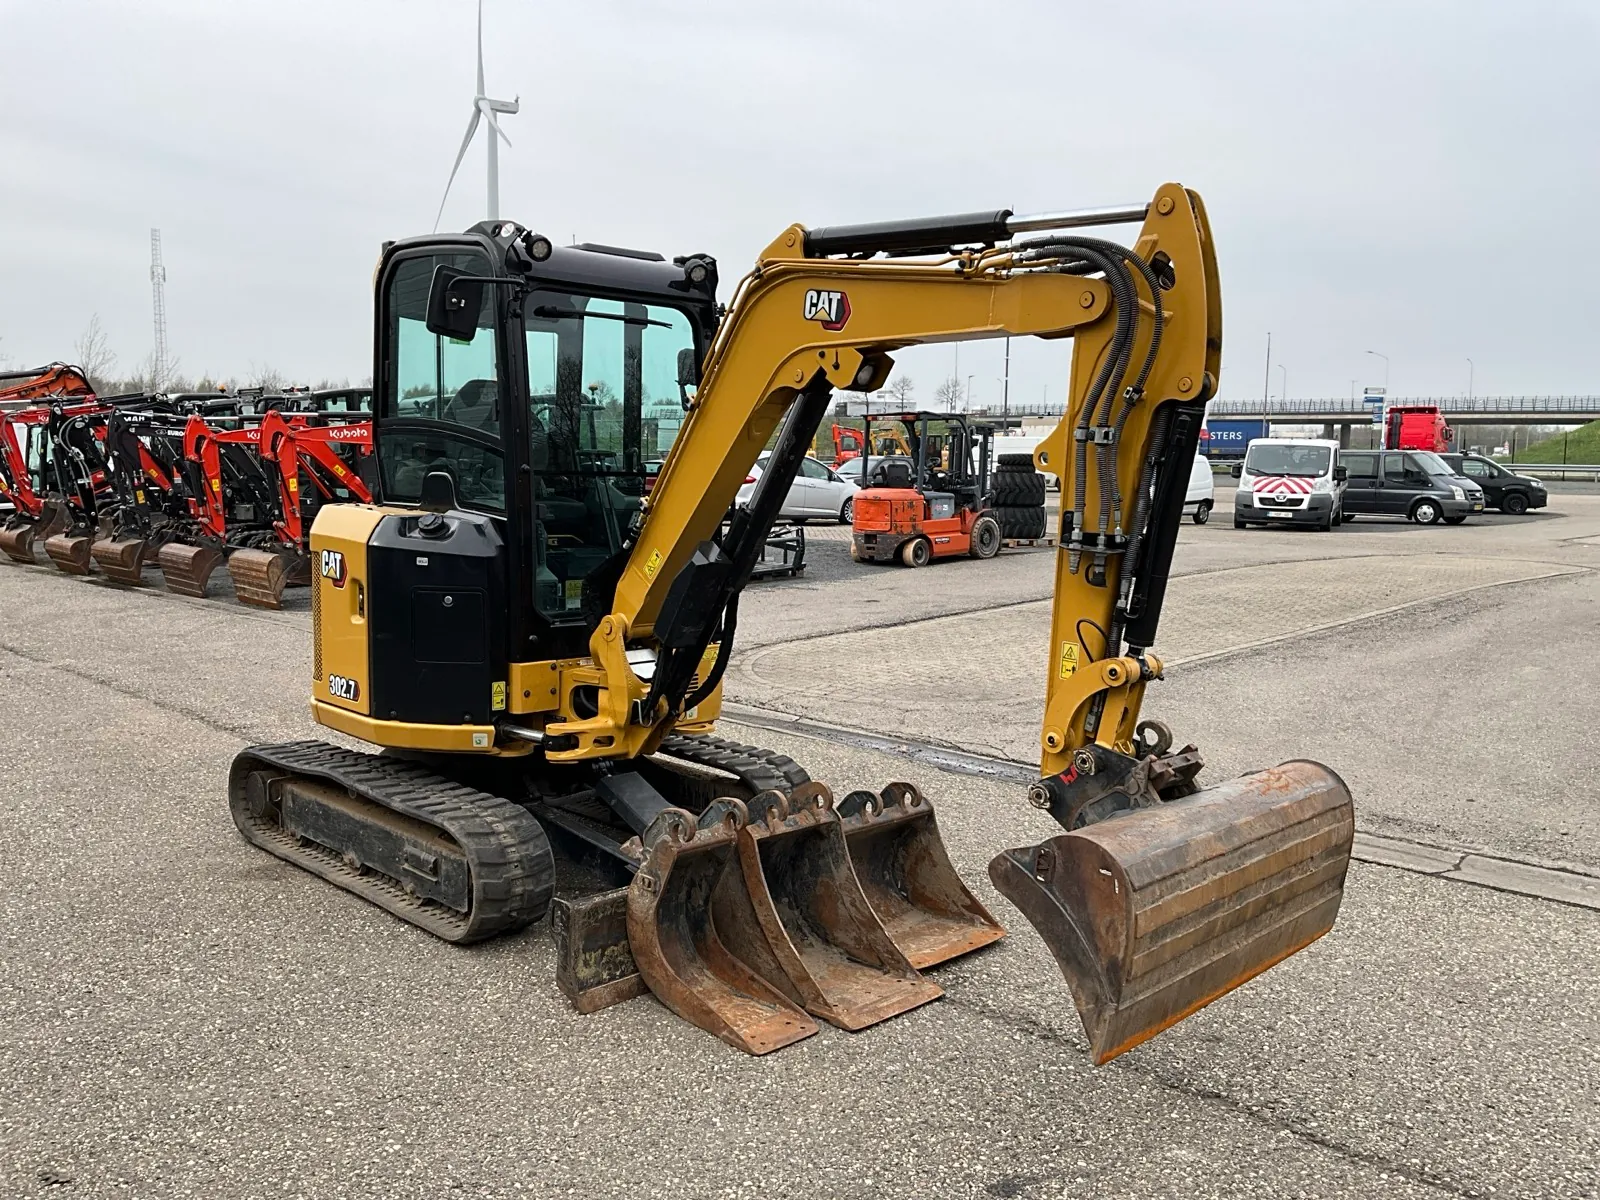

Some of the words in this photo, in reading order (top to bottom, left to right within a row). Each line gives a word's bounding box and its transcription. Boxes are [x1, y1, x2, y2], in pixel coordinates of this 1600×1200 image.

[805, 290, 842, 322] CAT
[329, 428, 368, 440] Kubota
[322, 550, 342, 580] CAT
[329, 674, 355, 700] 302.7
